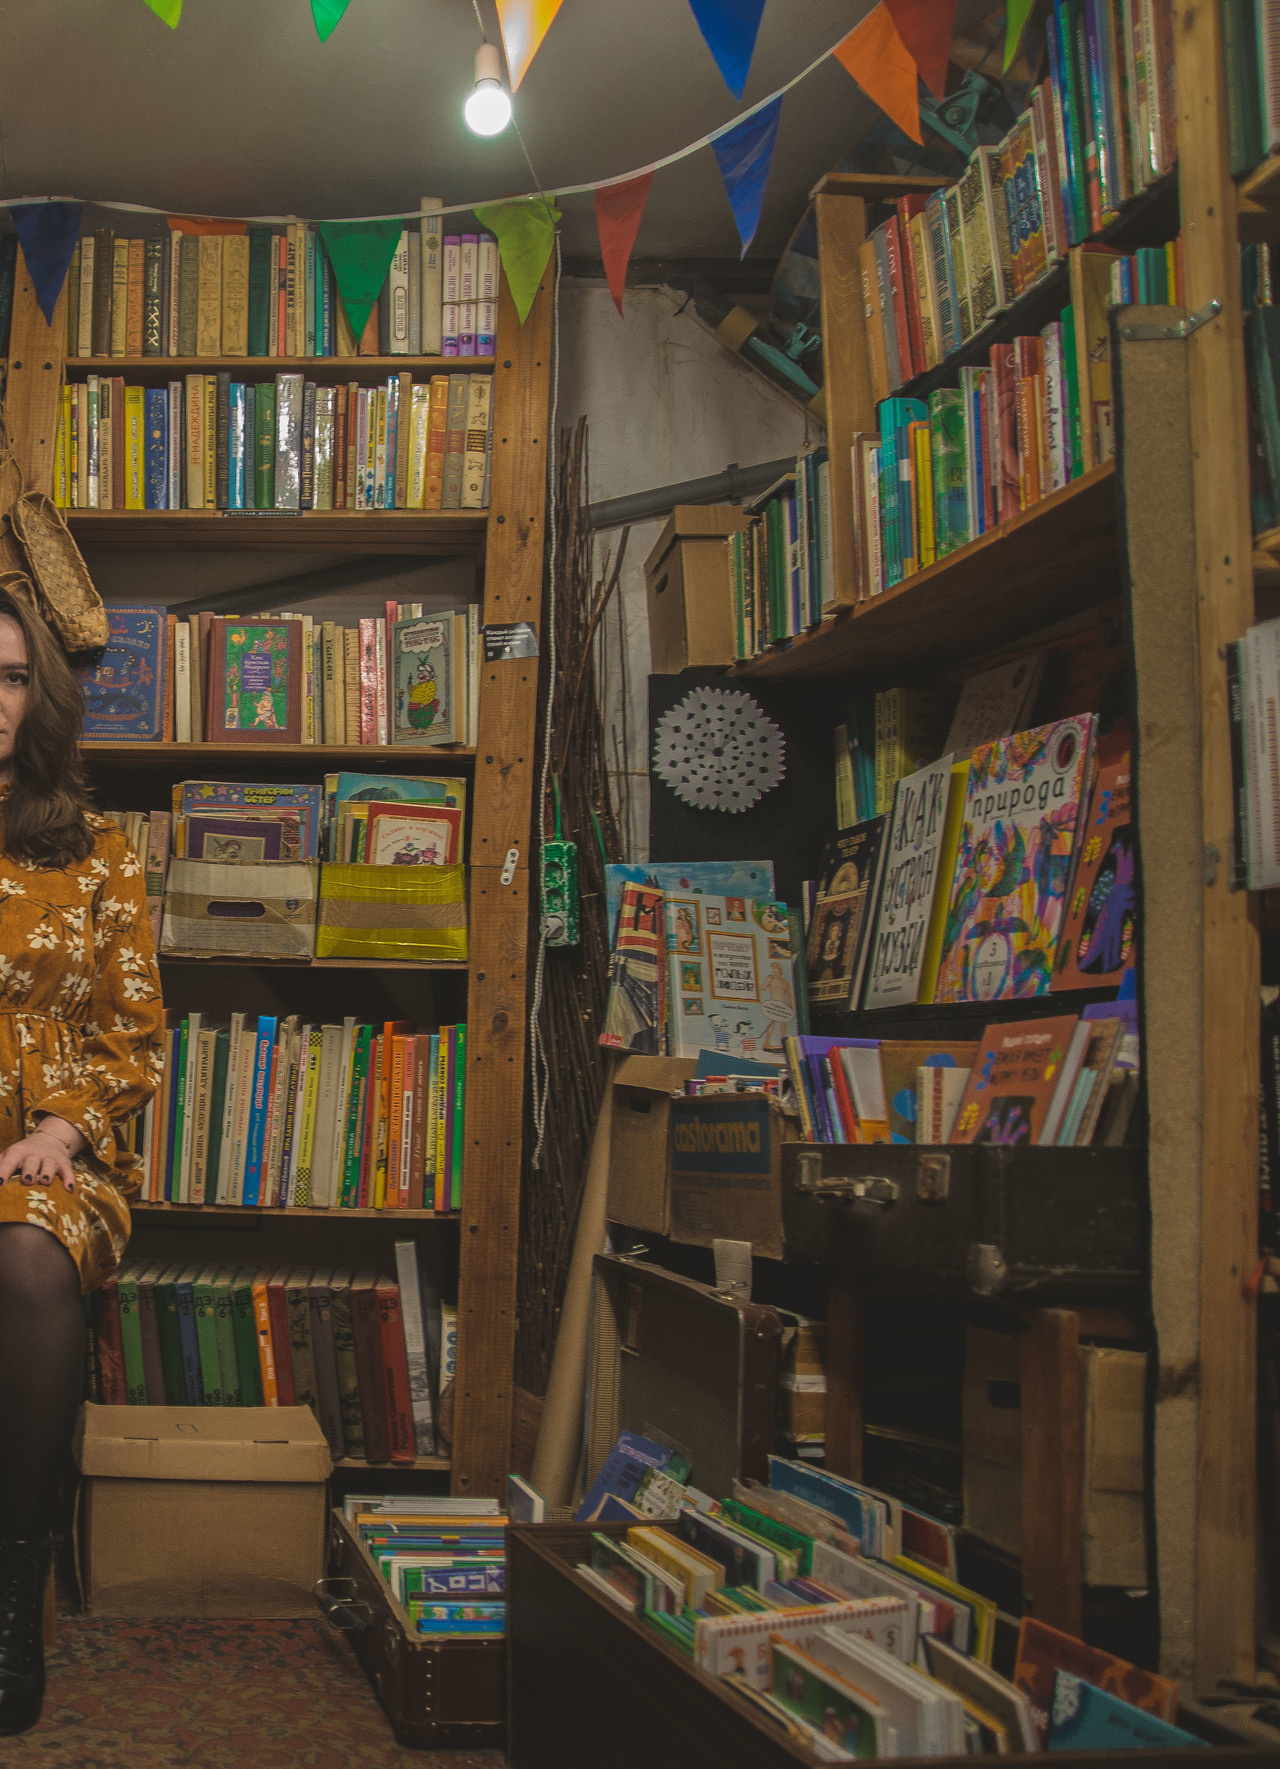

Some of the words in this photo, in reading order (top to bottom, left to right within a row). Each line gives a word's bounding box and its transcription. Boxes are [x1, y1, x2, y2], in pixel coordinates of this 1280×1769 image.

[286, 242, 295, 265] БЫТУ
[286, 278, 295, 308] ХИМИЯ
[101, 458, 109, 499] КАЛЕНДАРЬ
[301, 452, 312, 478] Поттер
[301, 479, 312, 500] Гарри
[243, 786, 295, 799] ГРИГОРИЙ
[243, 795, 277, 805] ОСТЕР
[972, 776, 1067, 823] природа
[895, 772, 945, 852] КАК
[884, 847, 938, 913] УСТРОЕН
[713, 939, 751, 954] ПОЧЕМУ
[872, 913, 927, 978] МУЗЕЙ
[715, 967, 752, 980] ГОЛЫХ
[200, 1040, 210, 1089] АДМИРАЛОВ
[242, 1049, 251, 1074] СКАЗОК
[393, 1052, 402, 1090] СКАЗКИ
[439, 1055, 447, 1084] СОВЕТЫ
[198, 1093, 208, 1131] БУДУЩИХ
[391, 1102, 400, 1134] СТИХИ
[196, 1135, 204, 1159] КНИГА
[283, 1114, 294, 1151] ПРАЗДНИК
[346, 1132, 355, 1167] ЖУКОВА
